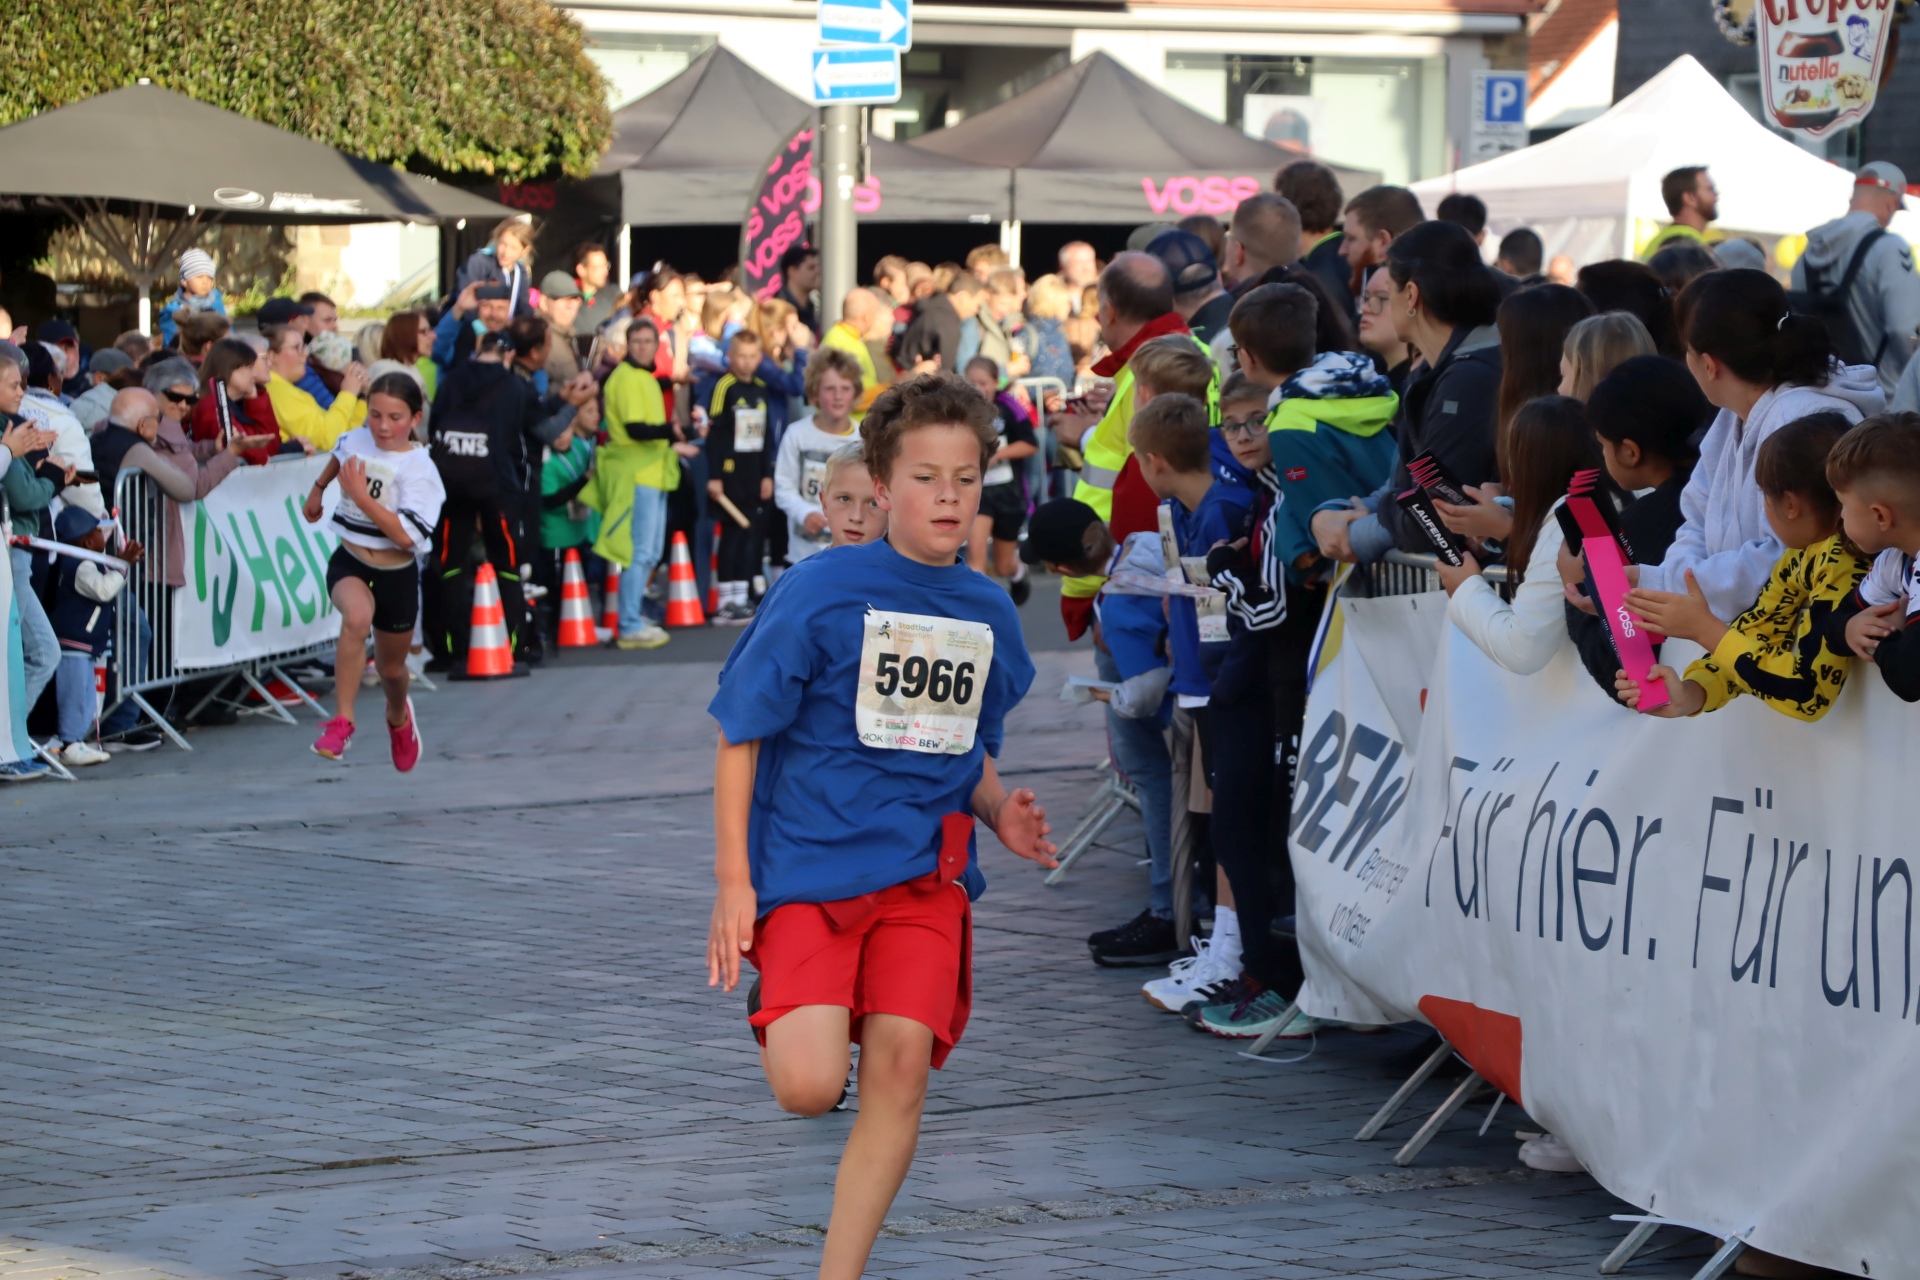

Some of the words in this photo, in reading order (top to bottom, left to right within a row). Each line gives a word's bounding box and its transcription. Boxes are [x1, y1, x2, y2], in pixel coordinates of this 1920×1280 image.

[1779, 56, 1840, 82] nutella
[1493, 81, 1517, 119] P
[1141, 176, 1260, 215] VOSS
[744, 210, 802, 279] VOSS
[1411, 503, 1449, 549] LAUFEND
[228, 494, 341, 632] Heli
[898, 622, 934, 632] Stadtlauf
[1617, 605, 1636, 639] VOSS
[875, 652, 975, 705] 5966
[862, 733, 884, 743] AOK
[918, 738, 941, 749] BEW
[1288, 709, 1414, 872] BEW
[1426, 756, 1516, 922] Für
[1516, 761, 1663, 961] hier.
[1693, 787, 1809, 988] Für
[1821, 849, 1920, 1025] un
